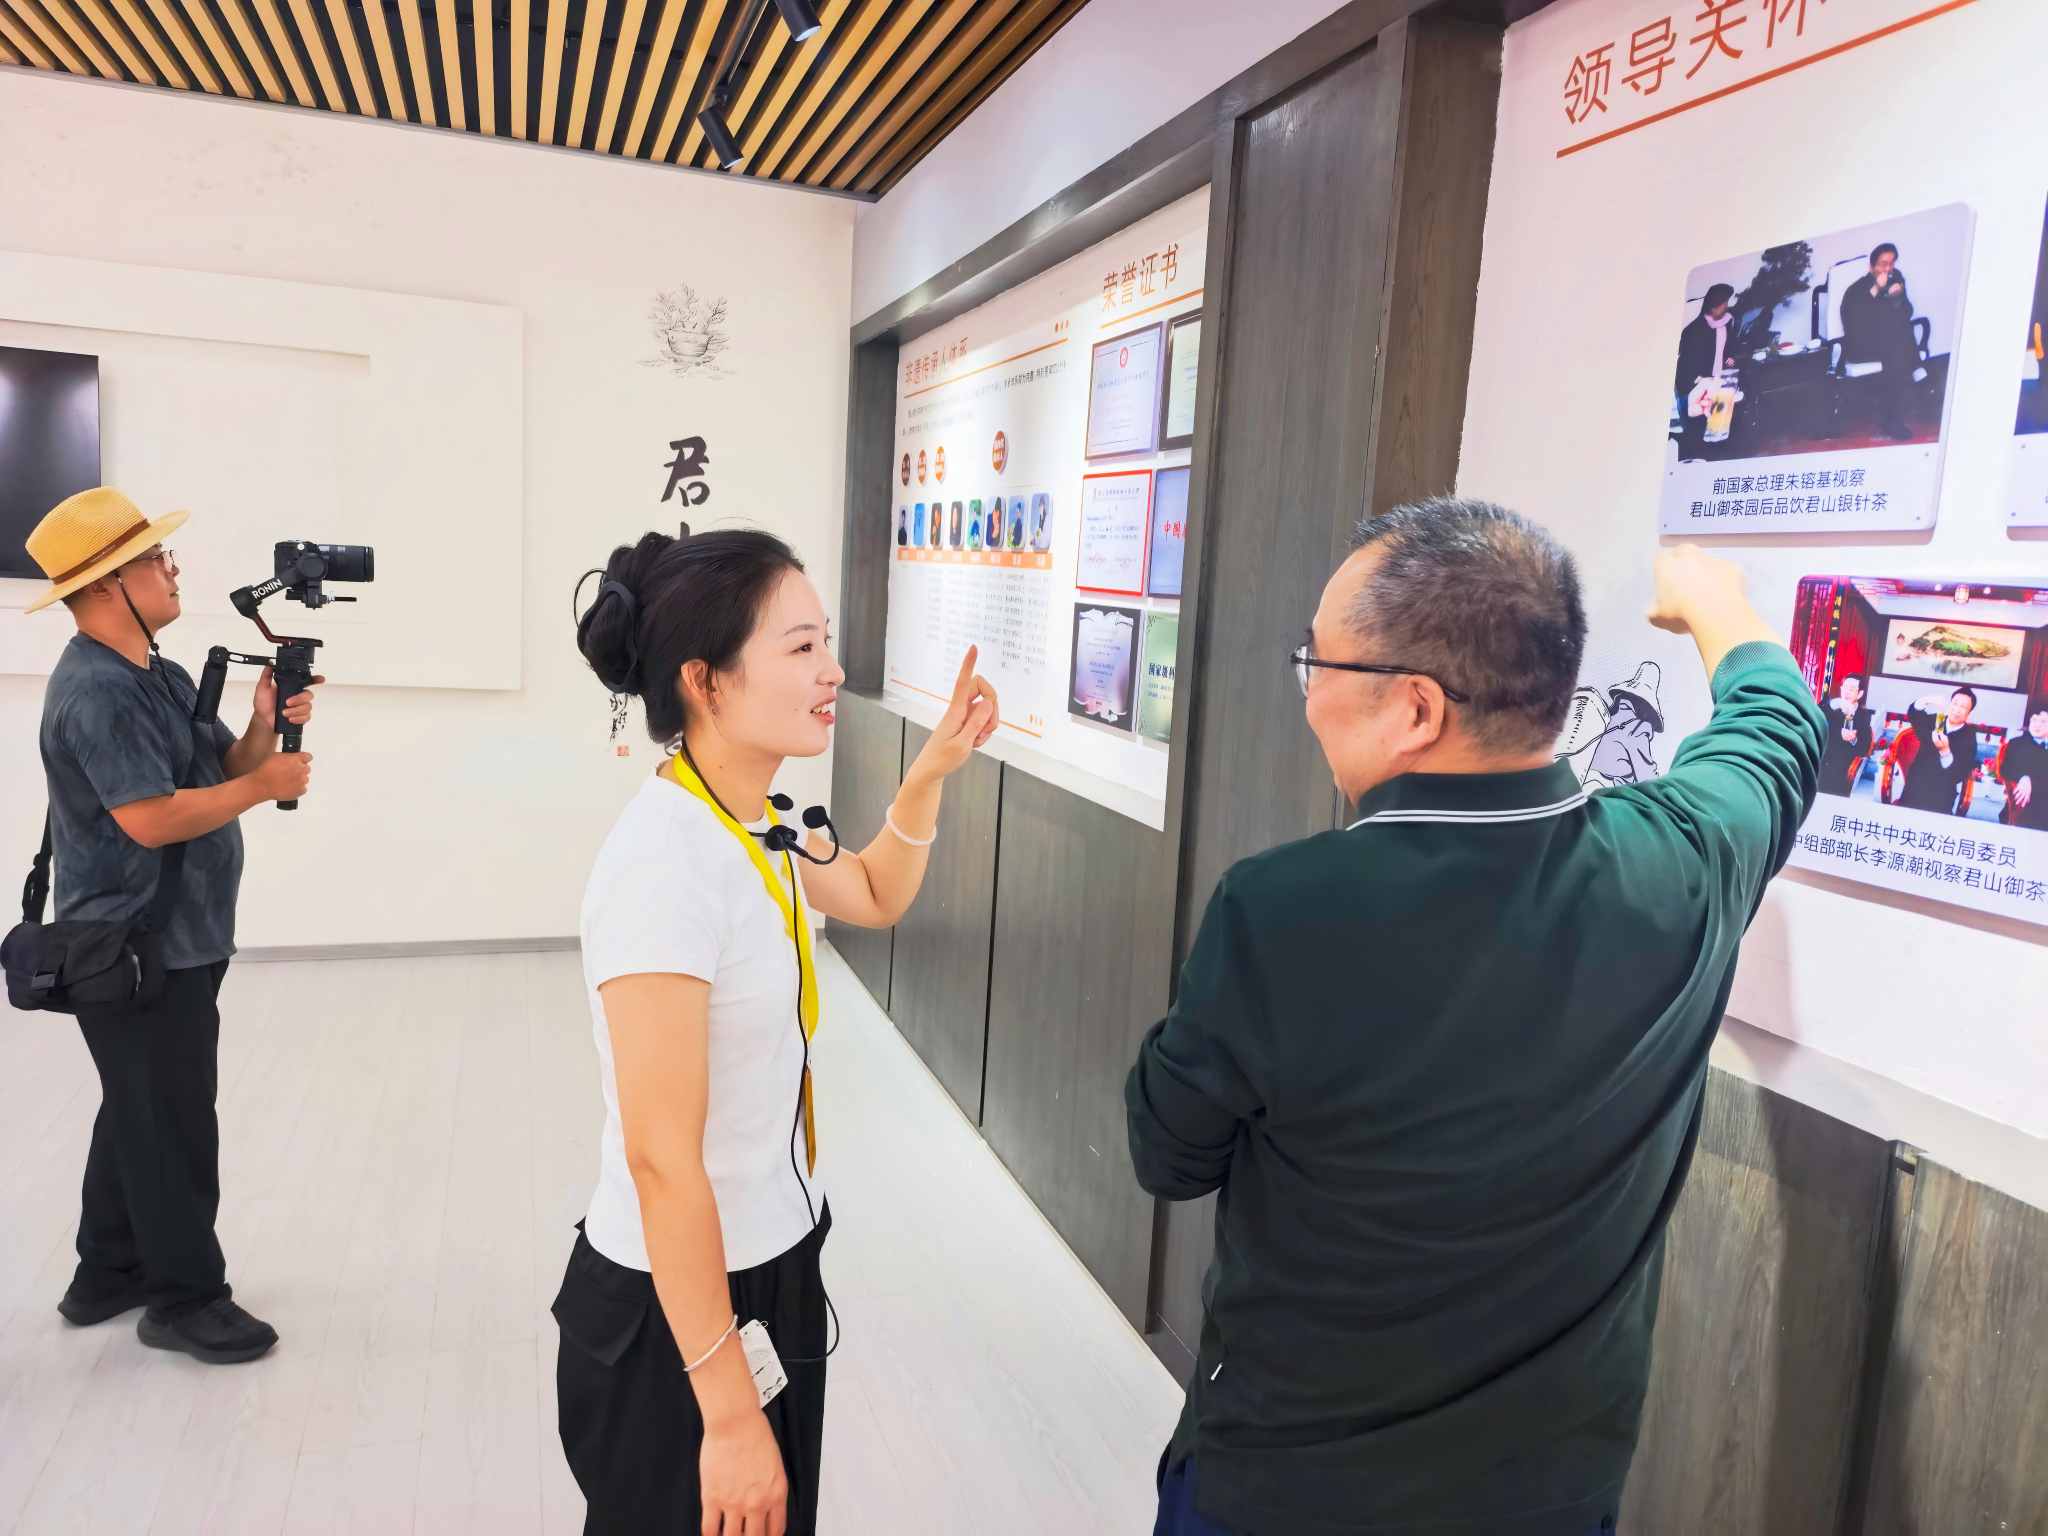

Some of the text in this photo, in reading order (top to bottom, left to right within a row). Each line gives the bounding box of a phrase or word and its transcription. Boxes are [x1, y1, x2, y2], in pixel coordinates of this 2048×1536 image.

[1102, 243, 1181, 312] 荣誉证书
[661, 435, 711, 543] 君
[1712, 469, 1866, 496] 前国家总理朱镕基视察
[1689, 493, 1888, 518] 君山御茶园后品饮君山银针茶
[1164, 519, 1188, 541] 中国
[252, 578, 283, 600] RONIN
[1830, 814, 2017, 869] 原中共中央政治局委员
